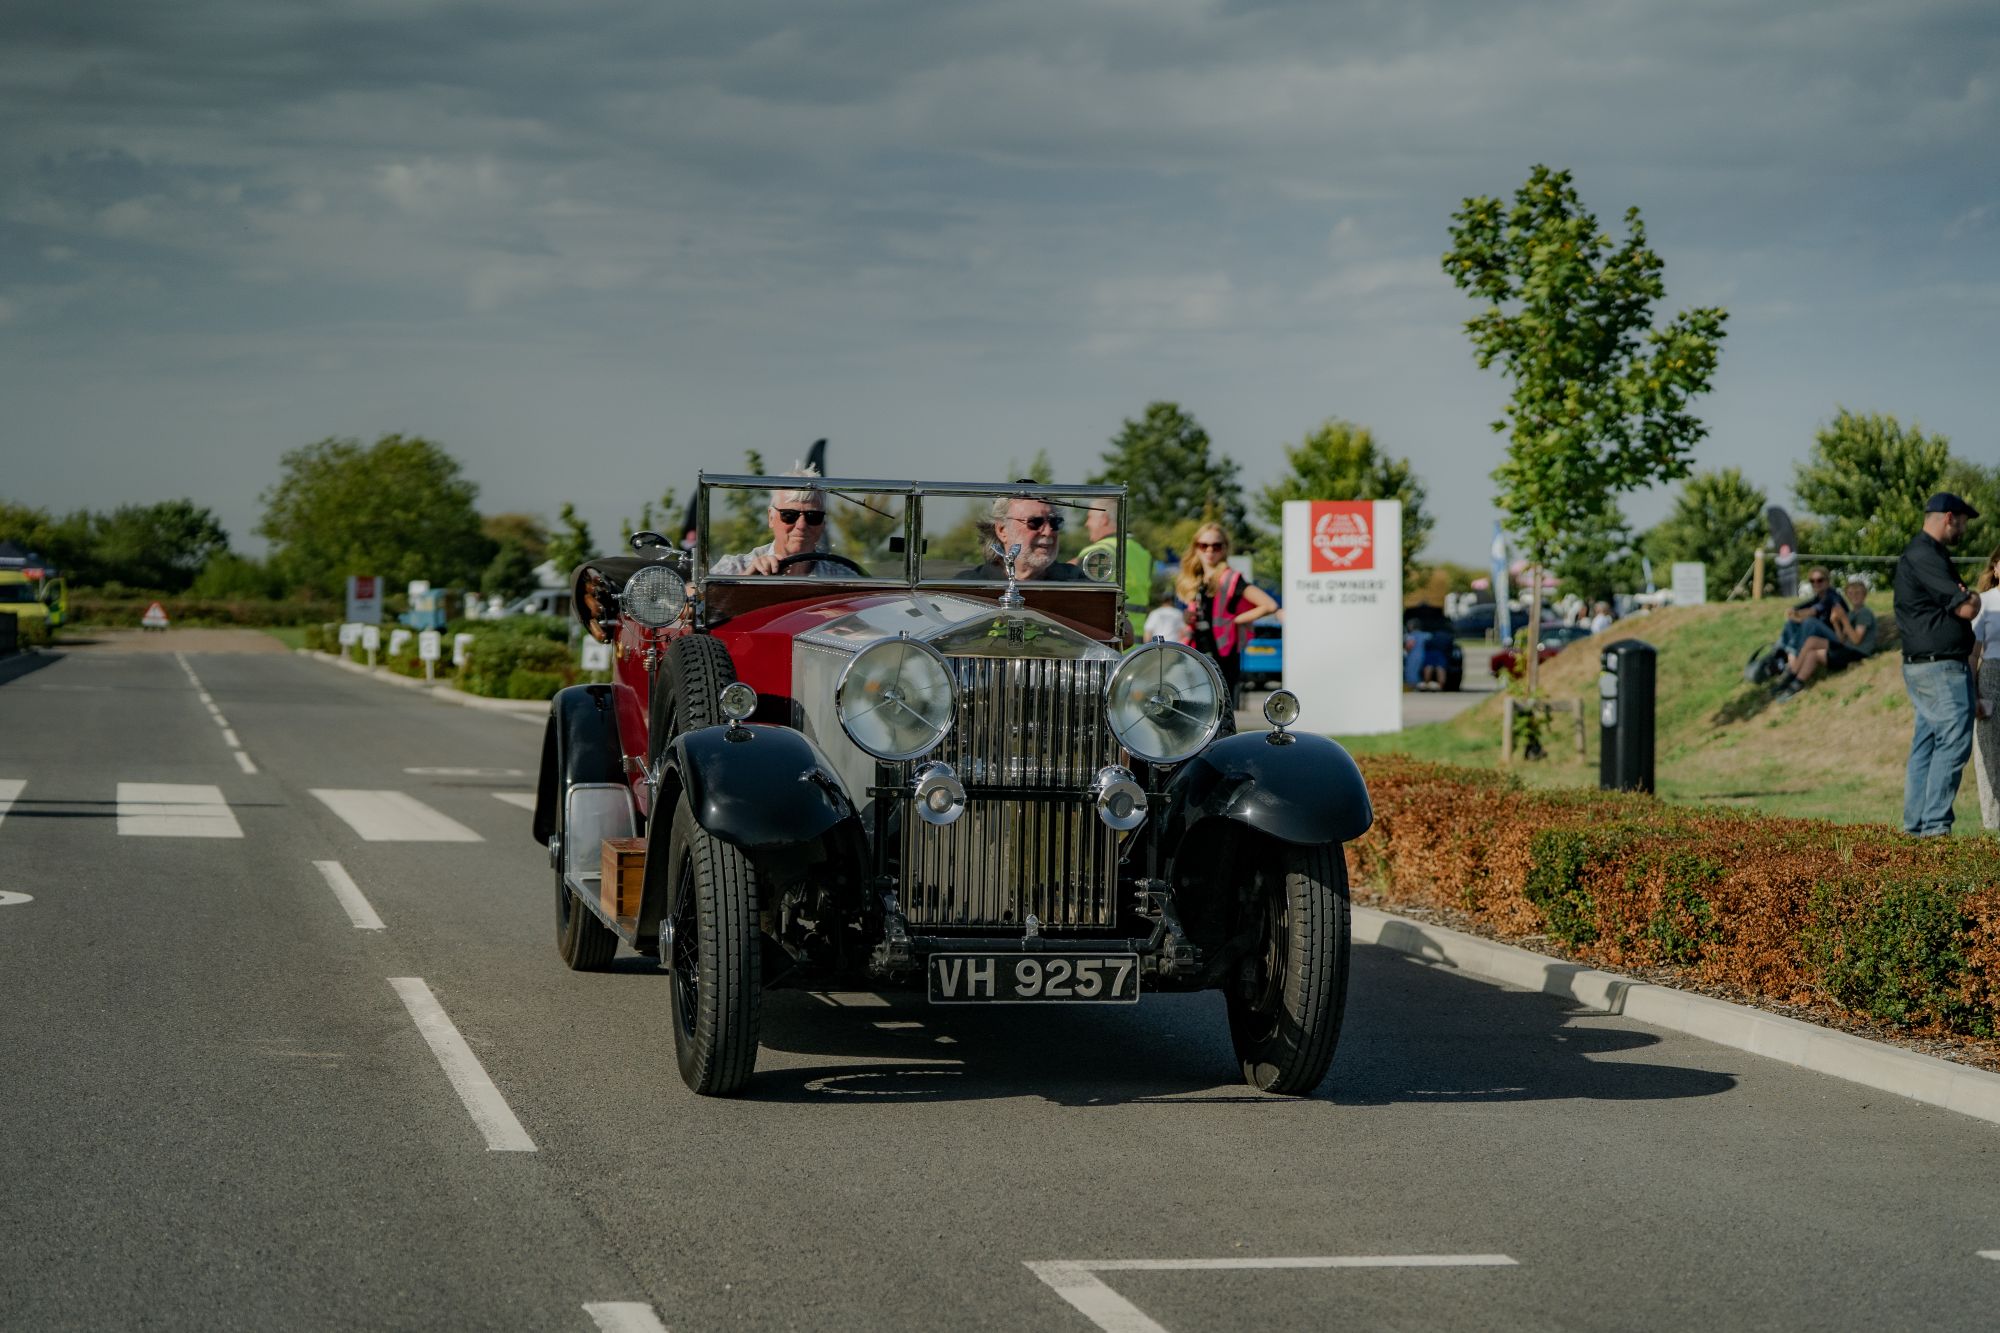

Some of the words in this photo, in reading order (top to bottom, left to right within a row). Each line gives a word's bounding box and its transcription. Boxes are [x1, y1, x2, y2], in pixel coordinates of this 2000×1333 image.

[1313, 534, 1371, 548] CLASSIC
[1296, 579, 1320, 590] THE
[1306, 593, 1334, 604] CAR
[1340, 593, 1377, 604] ZONE
[938, 958, 995, 997] VH
[1014, 958, 1133, 997] 9257
